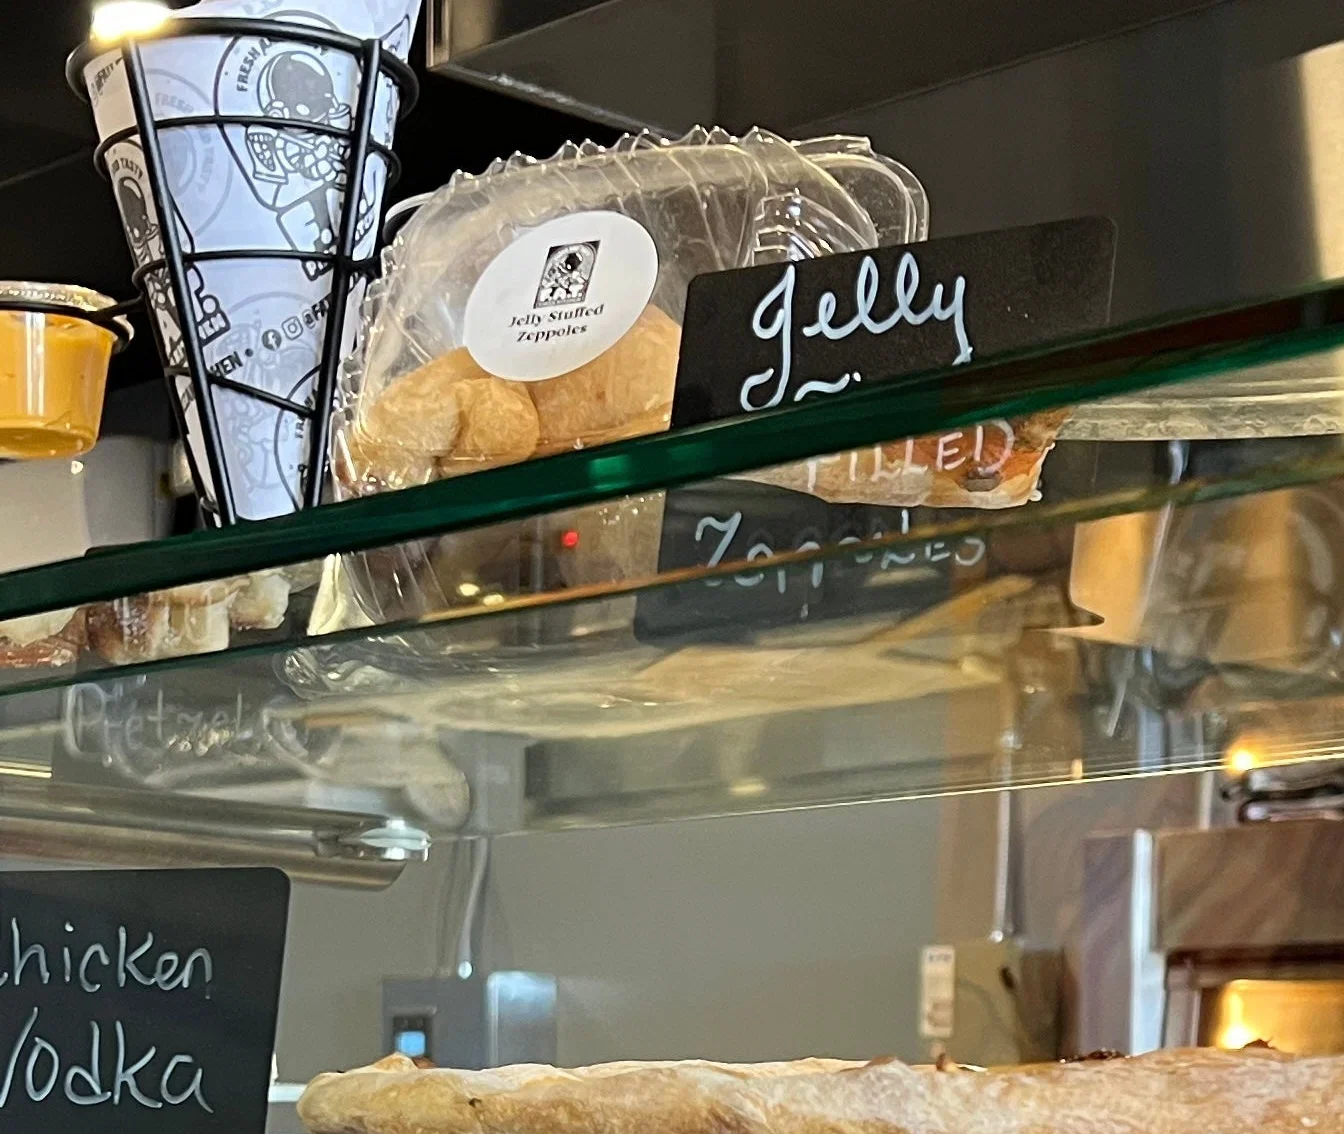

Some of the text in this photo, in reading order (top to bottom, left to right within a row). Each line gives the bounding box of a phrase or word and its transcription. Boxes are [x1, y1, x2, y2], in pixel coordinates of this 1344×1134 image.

[236, 46, 261, 92] FRESH
[509, 304, 605, 327] Jelly Stuffed
[741, 252, 973, 411] Jelly
[517, 325, 588, 342] Zeppoles
